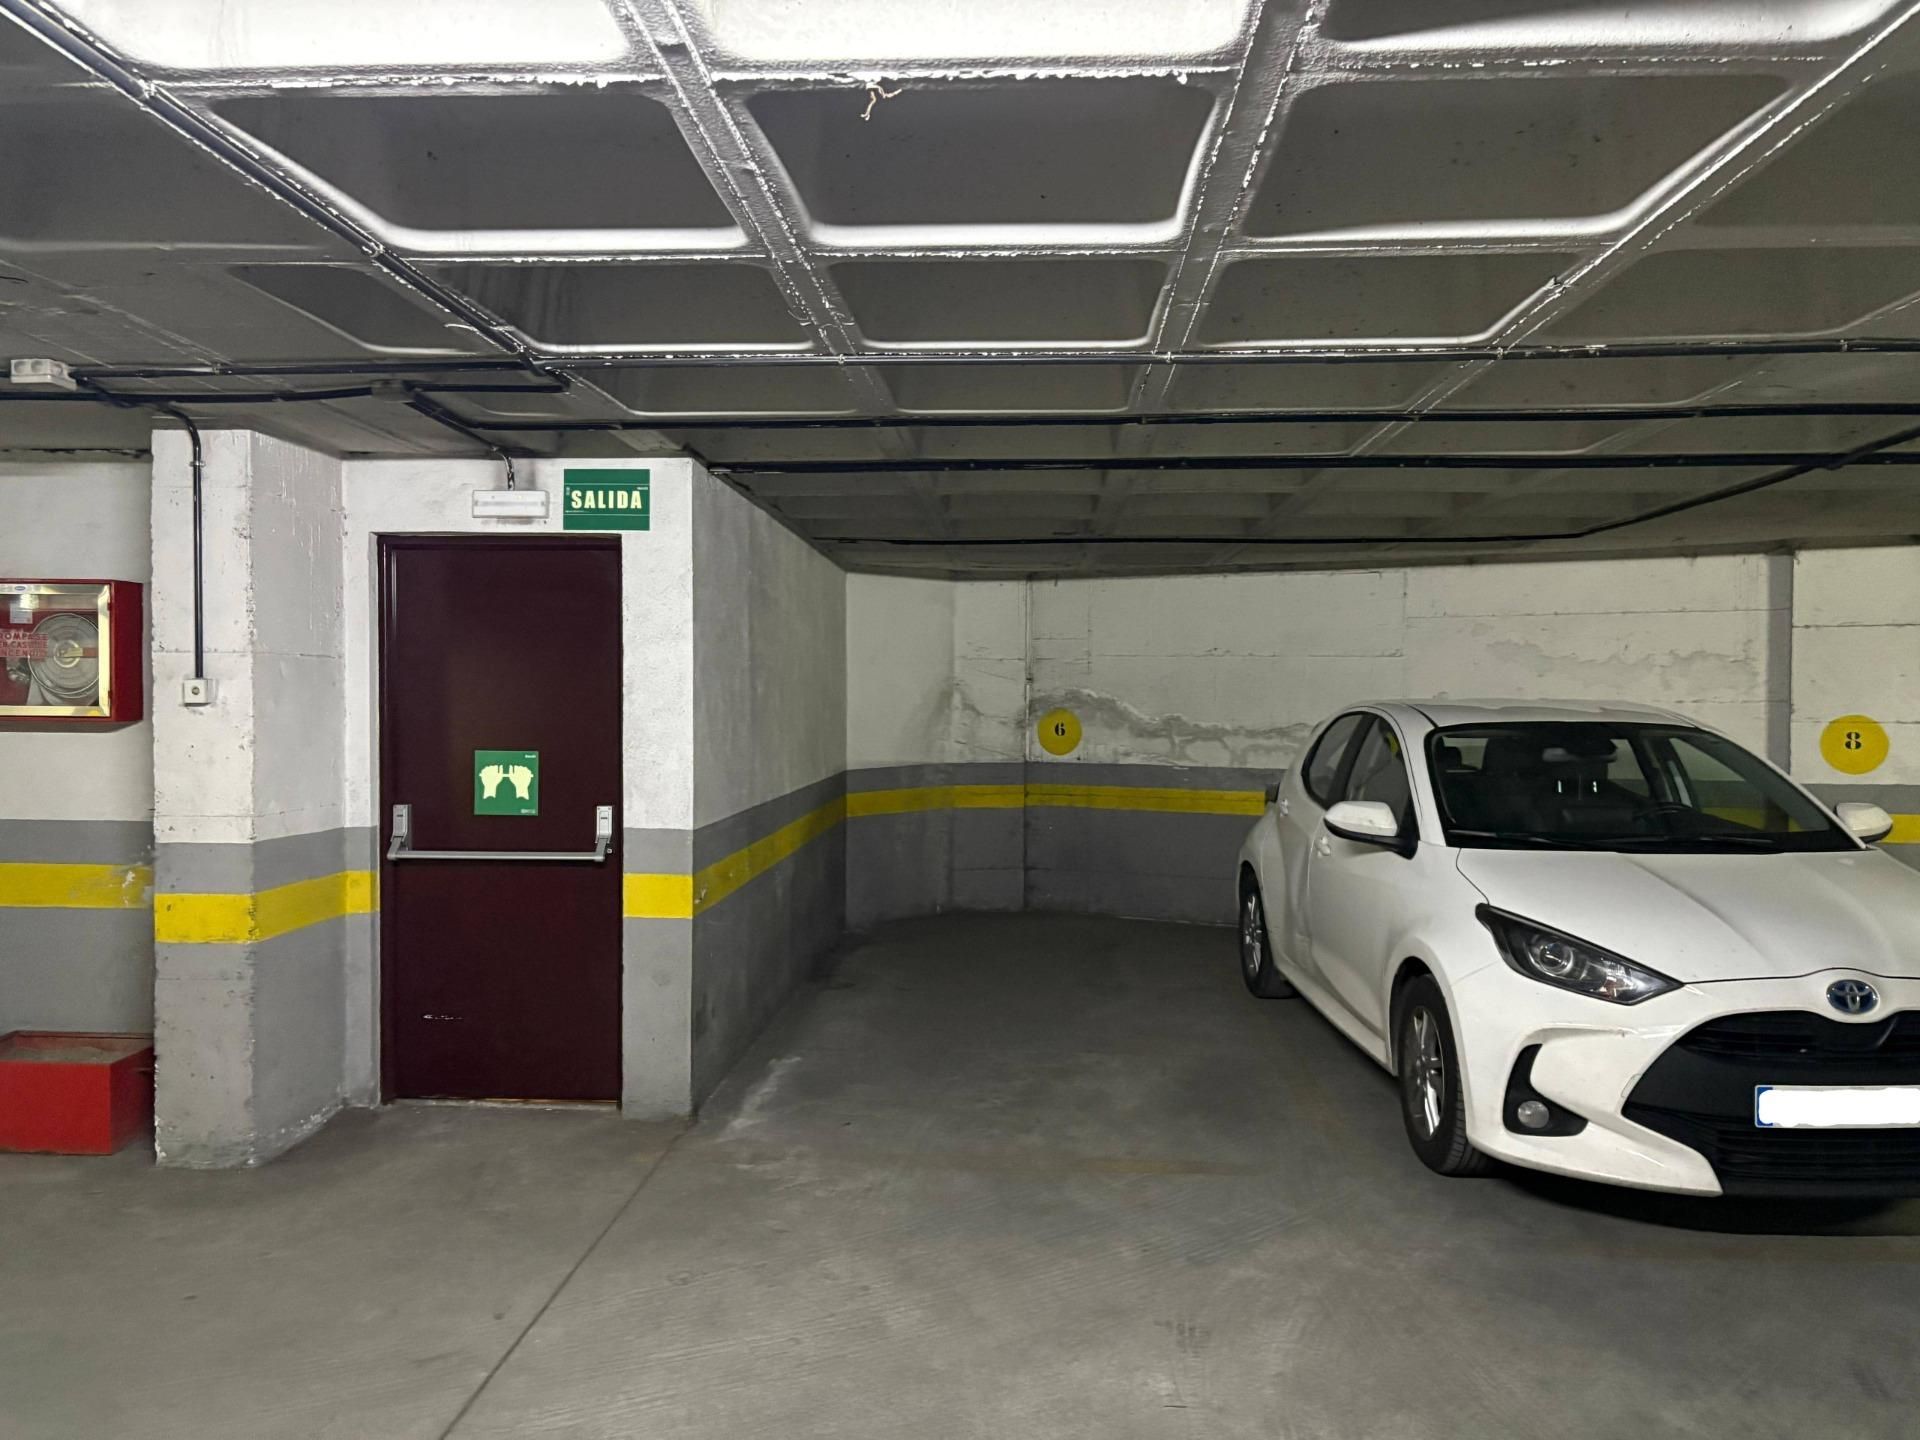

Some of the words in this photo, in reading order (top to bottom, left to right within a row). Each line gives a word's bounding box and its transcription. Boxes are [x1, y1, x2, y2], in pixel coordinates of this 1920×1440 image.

[571, 489, 642, 509] SALIDA
[1054, 722, 1066, 736] 6
[1845, 731, 1862, 750] 8
